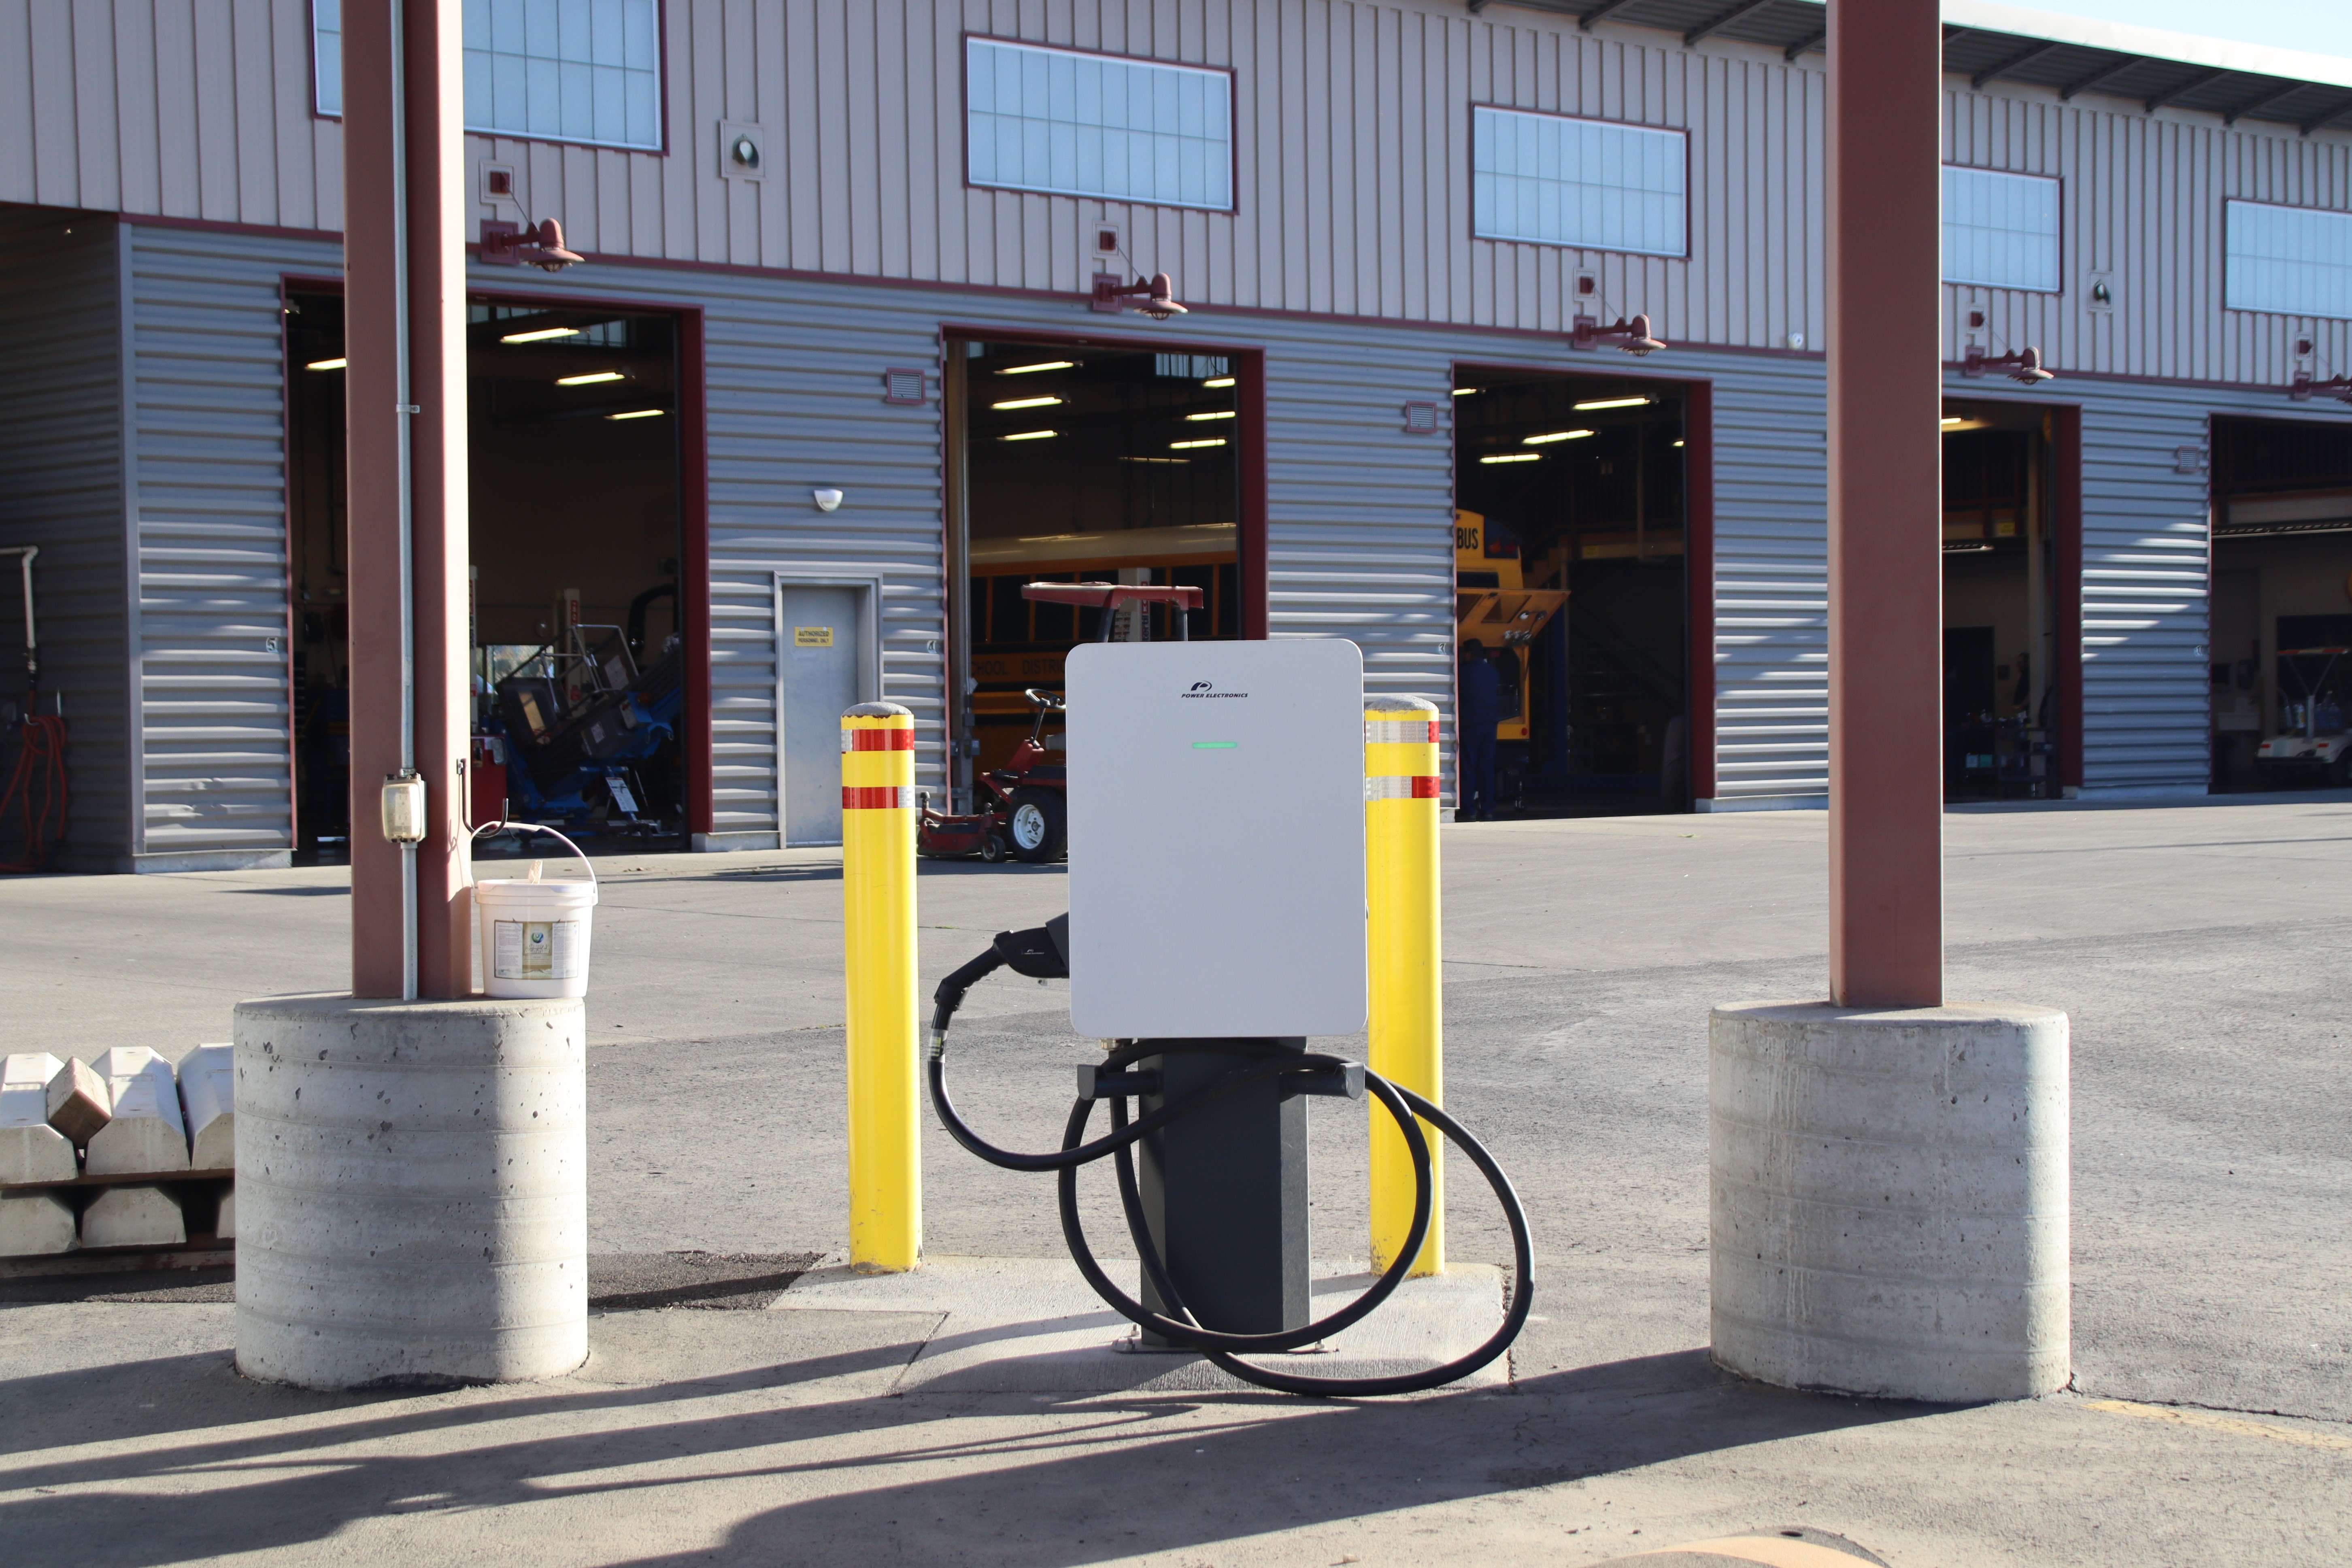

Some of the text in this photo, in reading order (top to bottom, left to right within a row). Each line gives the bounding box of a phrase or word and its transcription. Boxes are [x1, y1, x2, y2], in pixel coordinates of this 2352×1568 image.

[1457, 528, 1478, 549] BUS
[971, 659, 1065, 675] CHOOL DISTRIC
